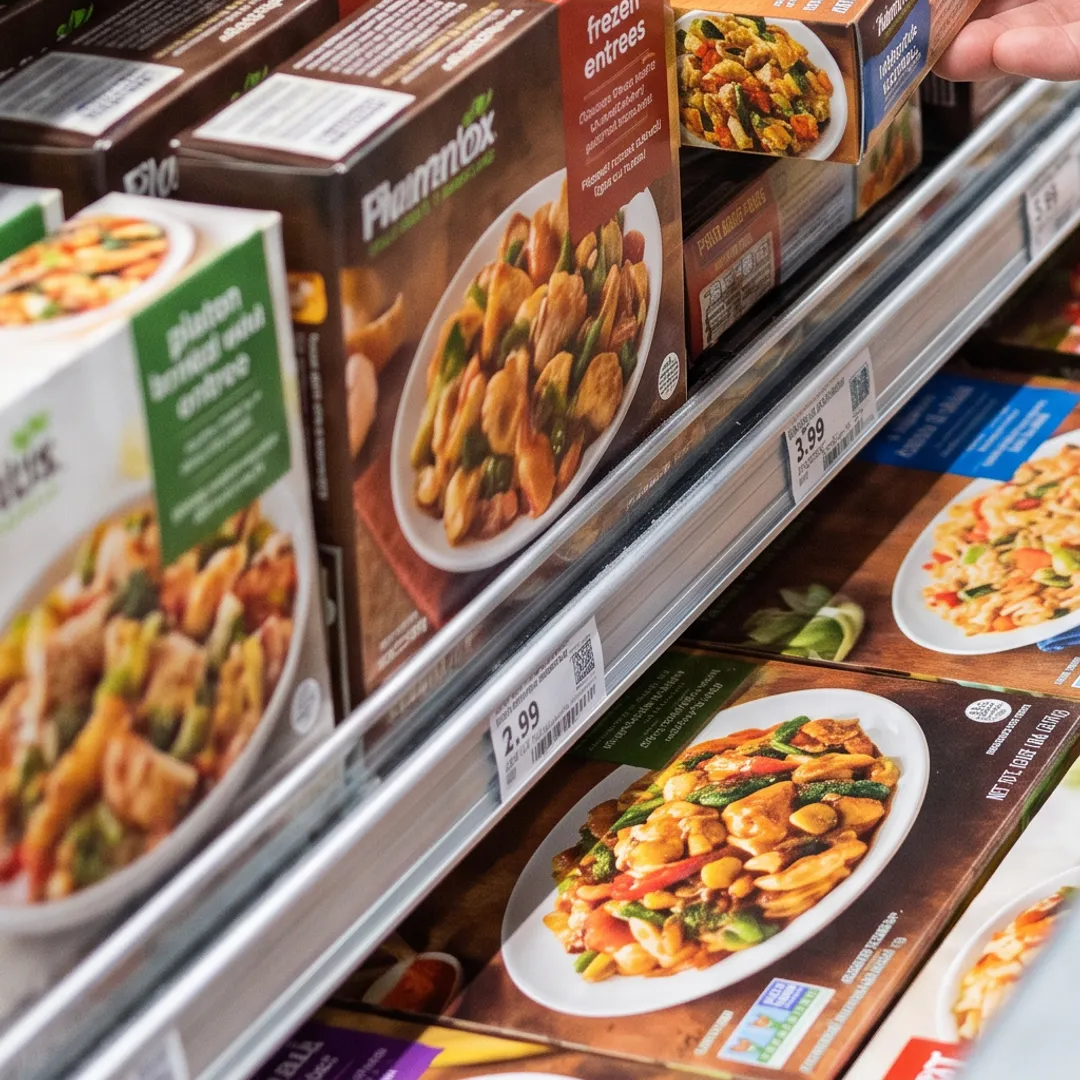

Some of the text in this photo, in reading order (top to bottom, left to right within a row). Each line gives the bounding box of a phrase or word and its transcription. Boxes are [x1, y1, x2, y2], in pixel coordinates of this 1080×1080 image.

[584, 19, 647, 79] entrees
[795, 417, 824, 463] 3.99
[502, 700, 540, 757] 2.99
